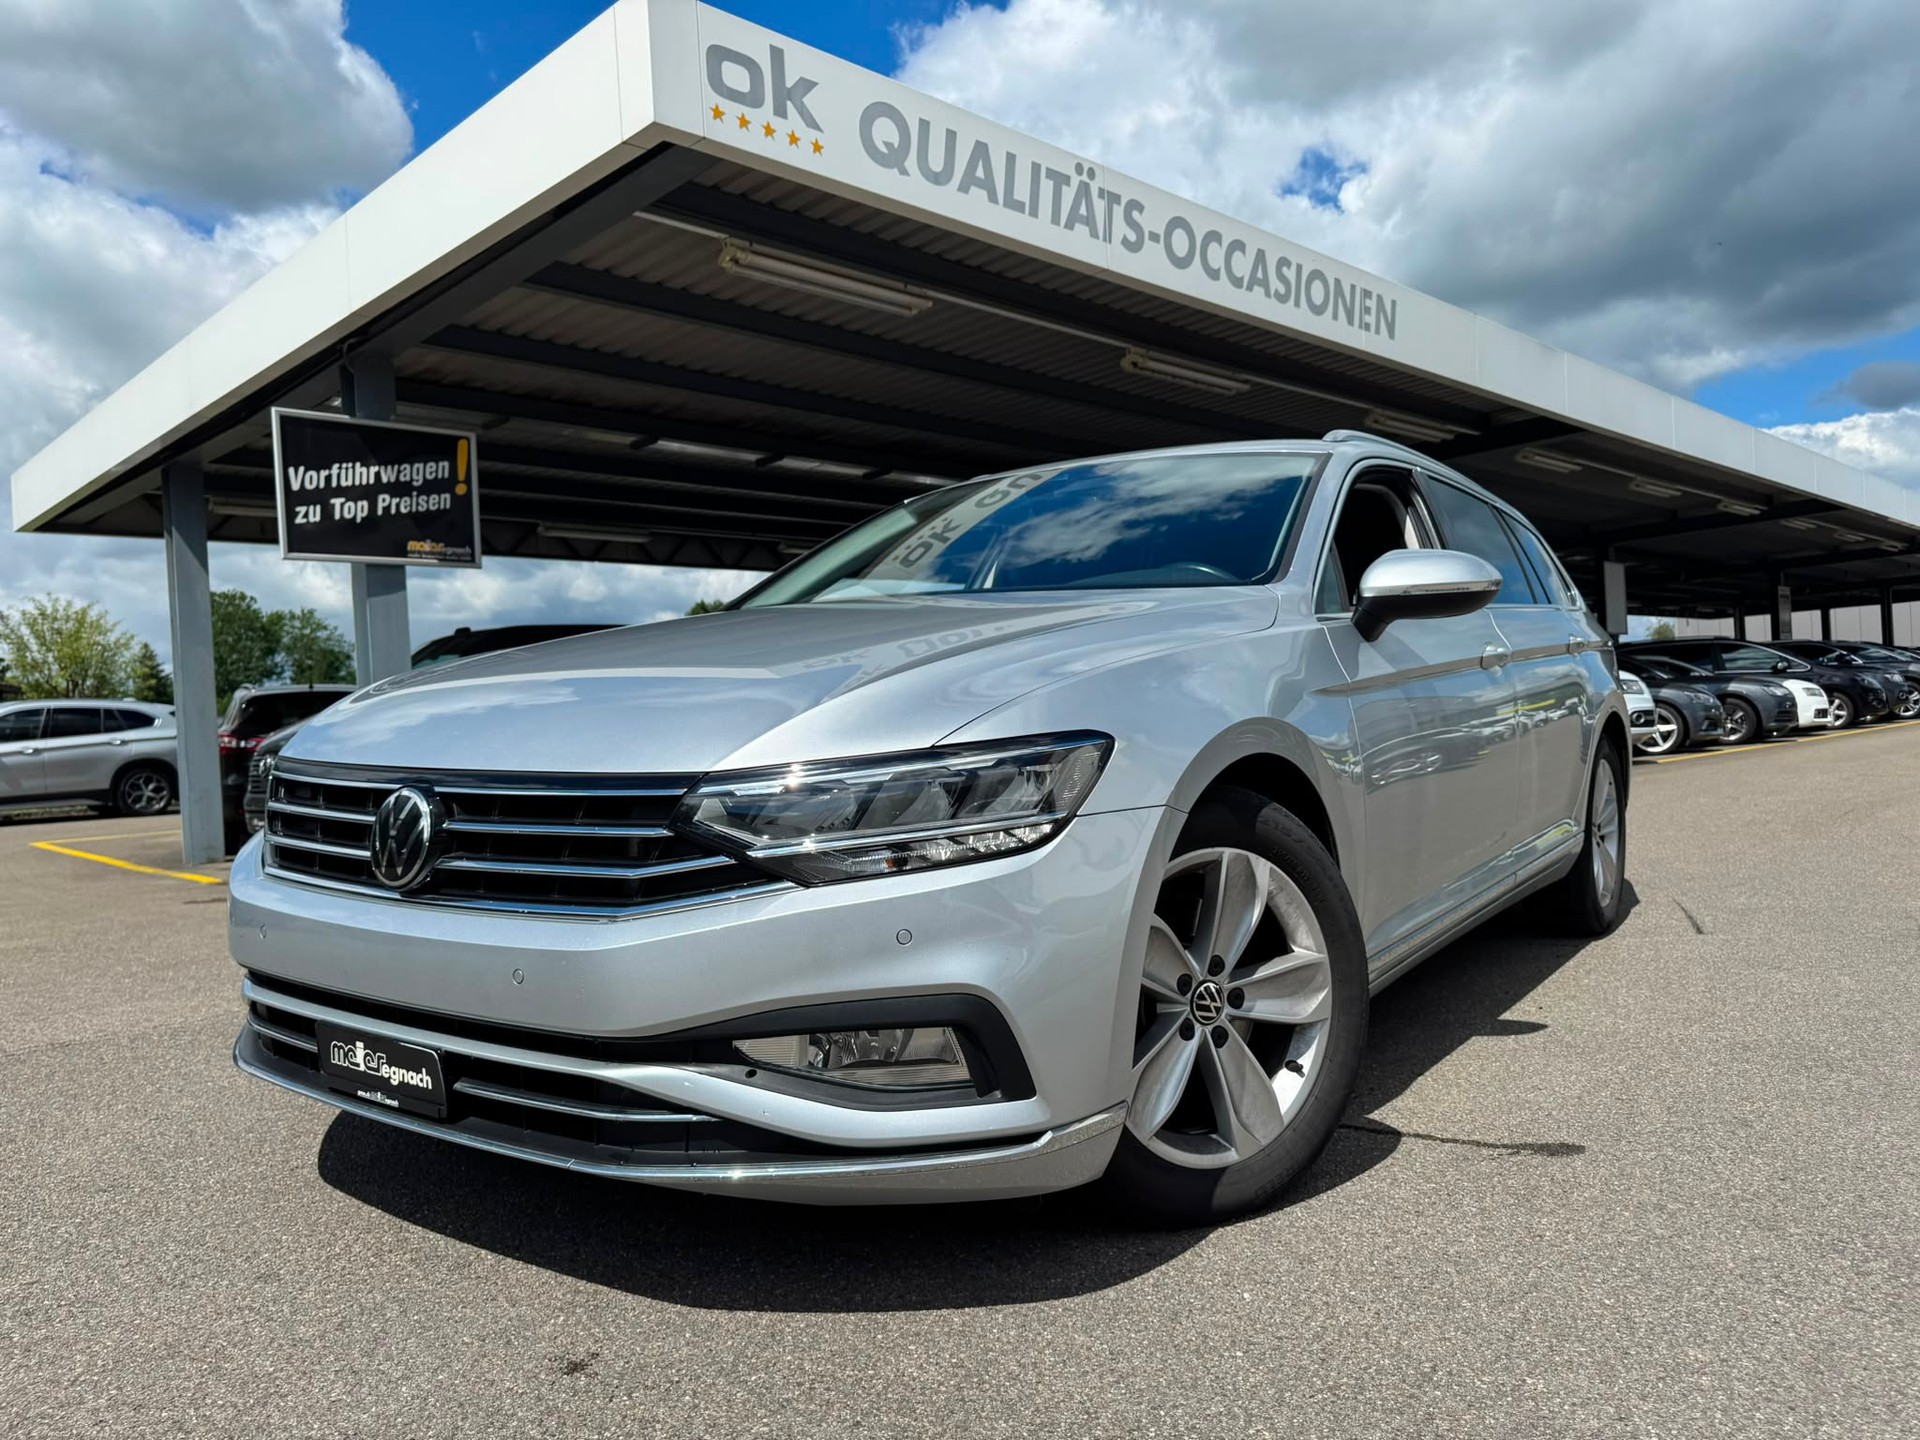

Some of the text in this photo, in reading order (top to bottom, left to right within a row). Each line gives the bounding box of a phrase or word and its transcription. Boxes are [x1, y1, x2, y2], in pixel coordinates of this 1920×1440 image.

[705, 43, 1397, 340] ok QUALITÄTS-OCCASIONEN
[287, 460, 449, 492] Vorführwagen
[294, 491, 451, 524] zu Top Preisen
